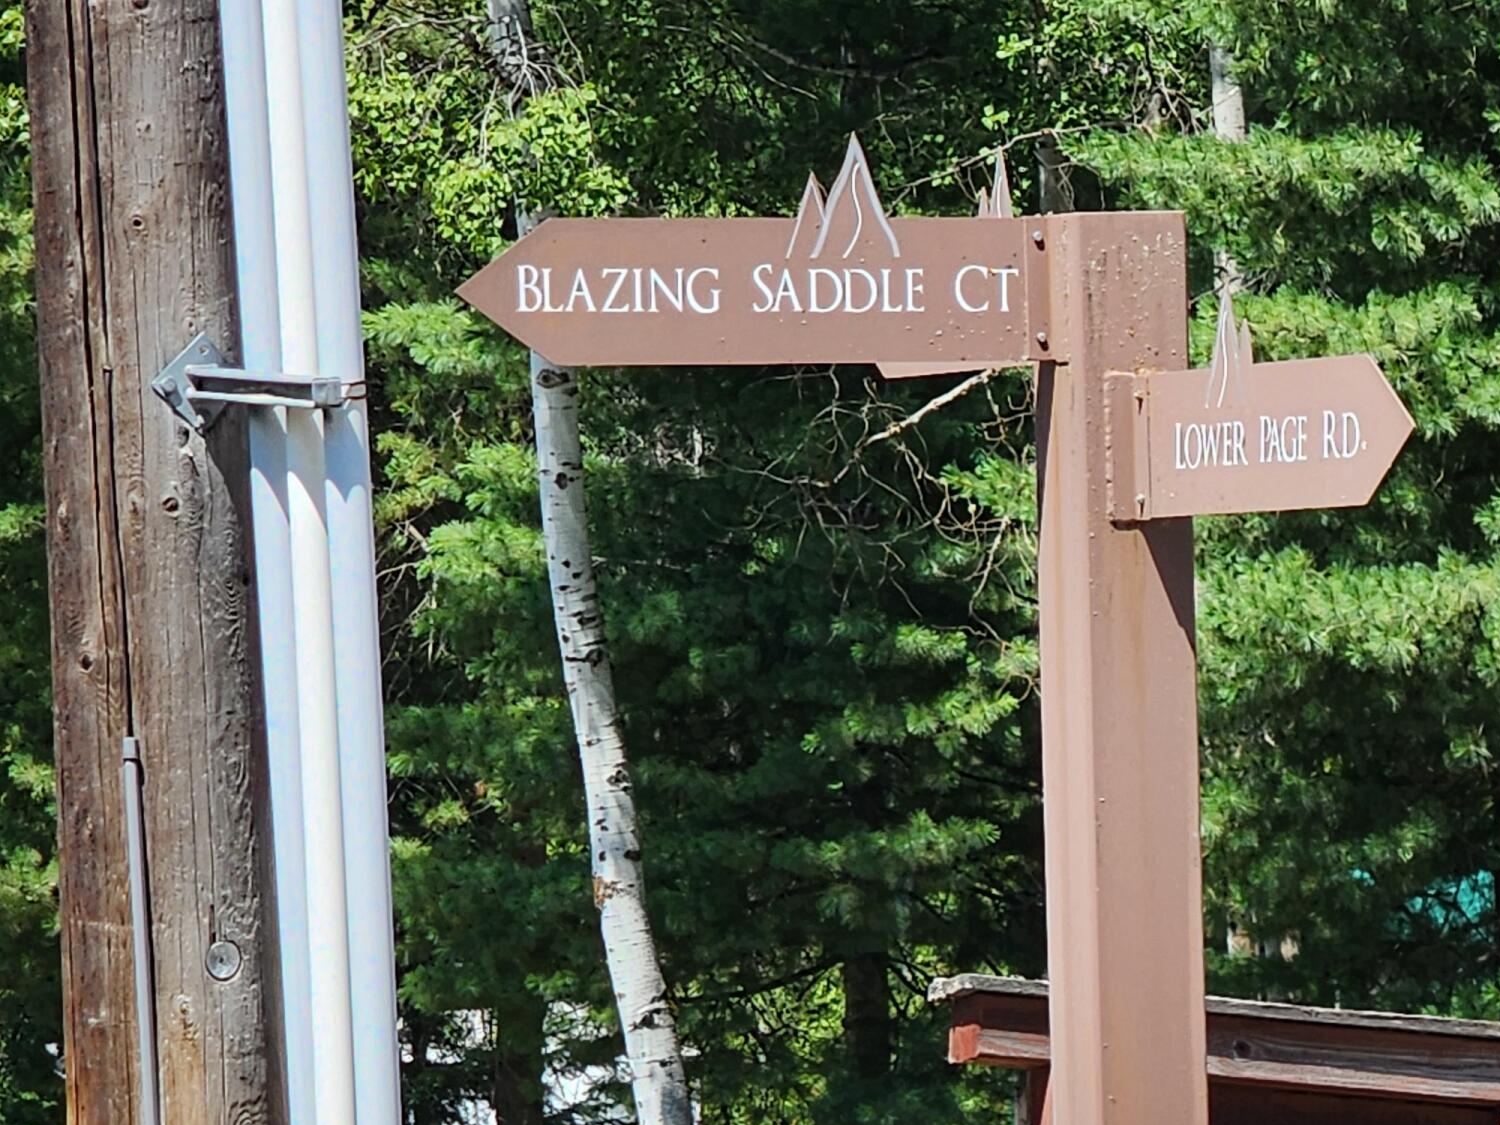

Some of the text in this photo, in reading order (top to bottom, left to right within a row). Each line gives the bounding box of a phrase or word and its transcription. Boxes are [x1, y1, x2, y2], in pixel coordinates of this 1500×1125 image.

[516, 264, 1019, 313] BLAZING SADDLE CT
[1175, 410, 1367, 469] LOWER PAGE RD.
